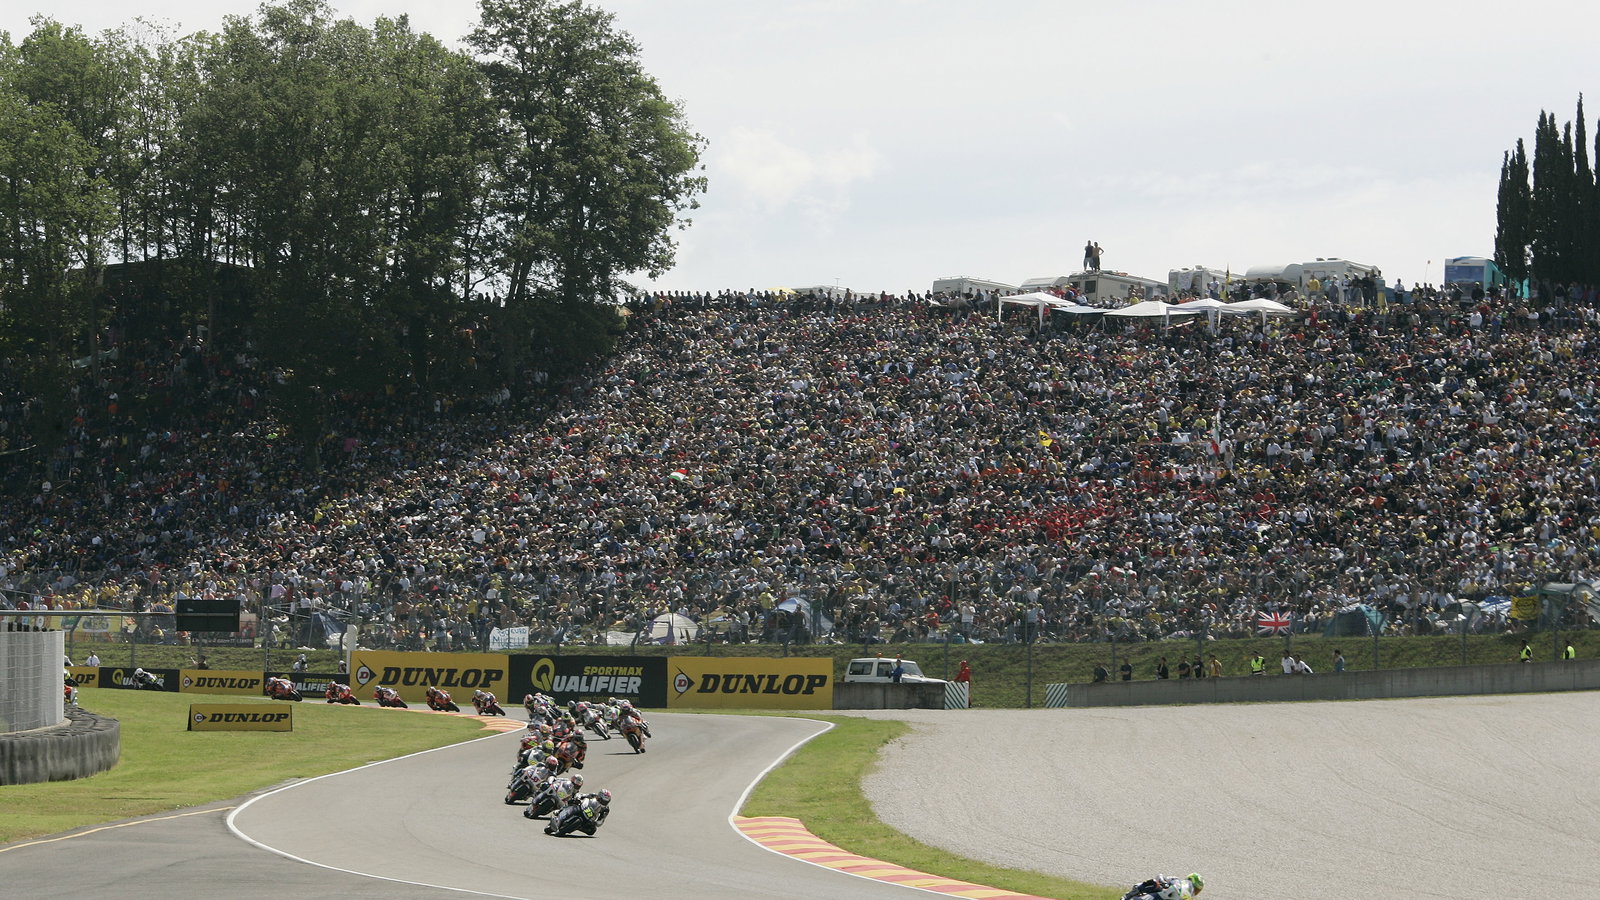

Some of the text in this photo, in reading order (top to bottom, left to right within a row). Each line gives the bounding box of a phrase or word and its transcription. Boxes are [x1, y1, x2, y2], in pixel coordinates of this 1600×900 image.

[378, 666, 504, 688] DUNLOP
[531, 657, 642, 694] QUALIFIER
[583, 666, 644, 676] SPORTMAX
[195, 677, 260, 689] DUNLOP
[697, 674, 828, 695] DUNLOP
[208, 713, 289, 723] DUNLOP
